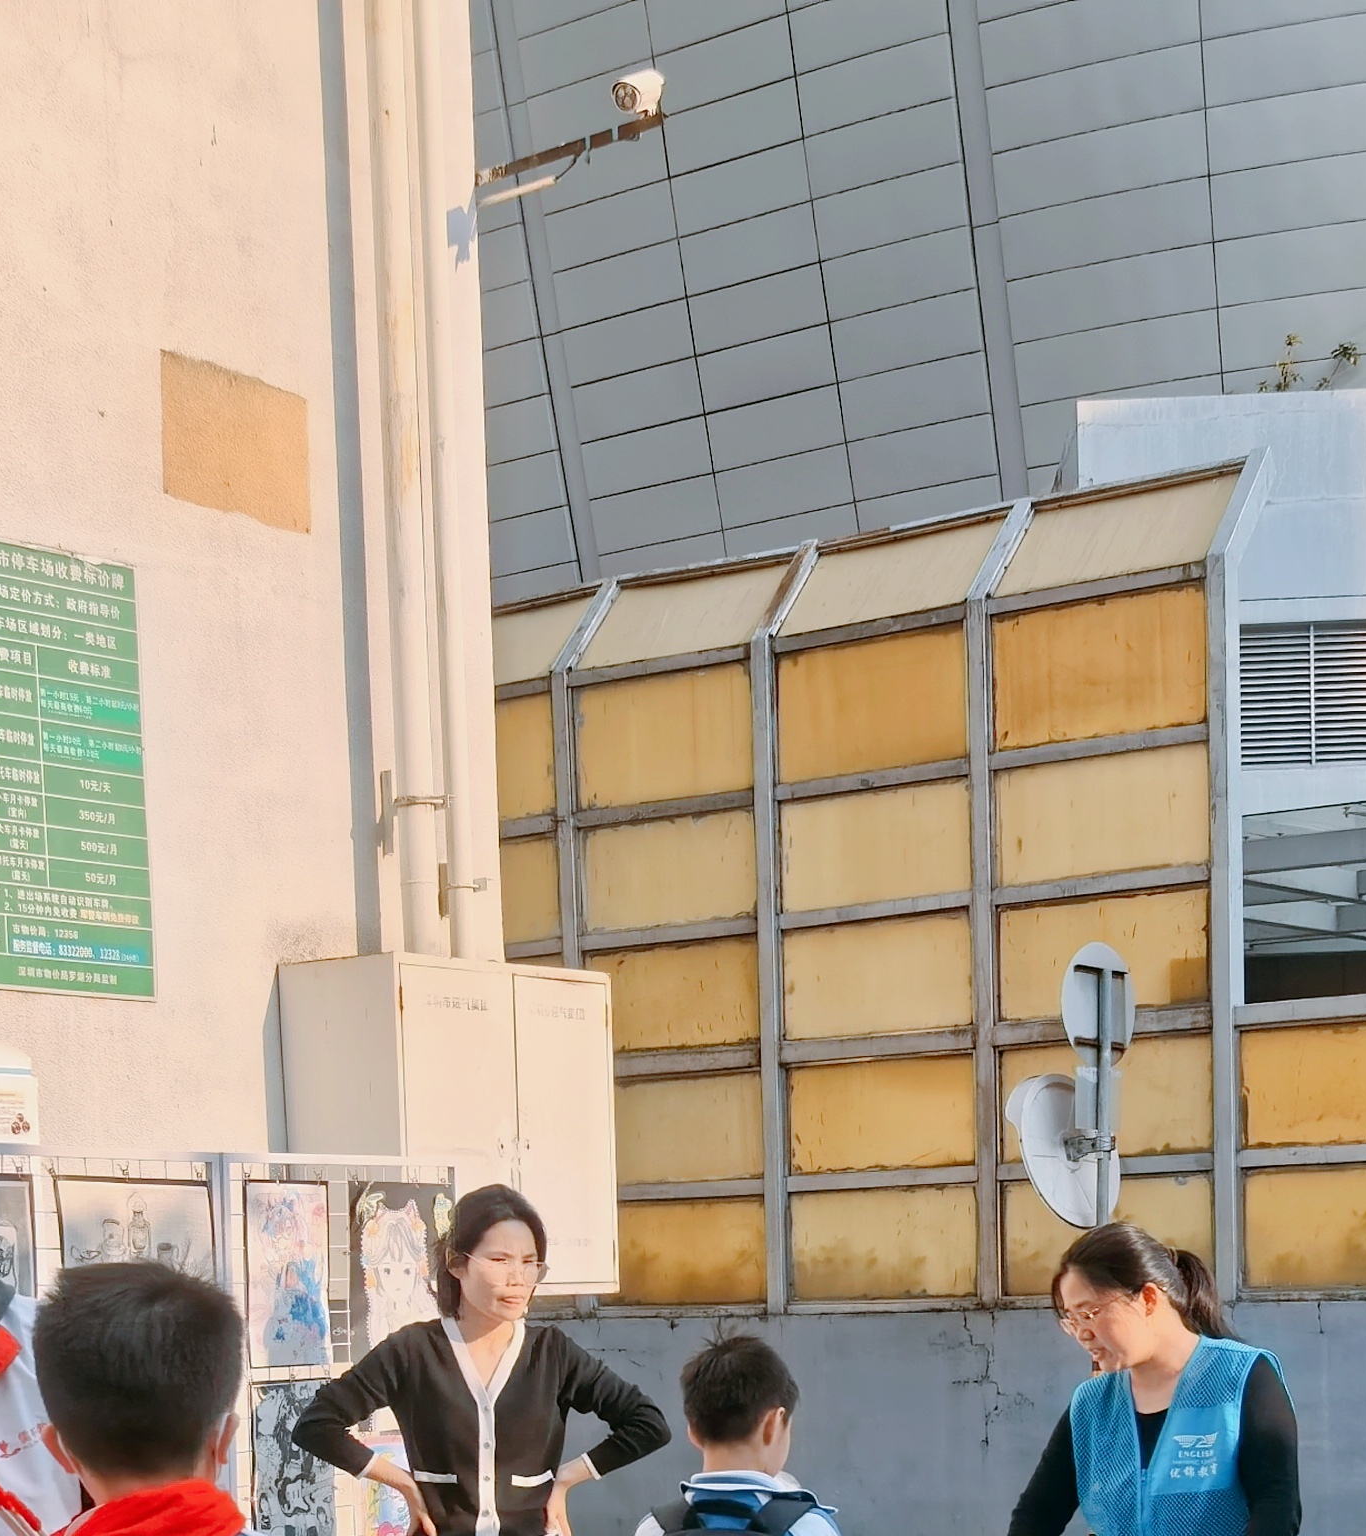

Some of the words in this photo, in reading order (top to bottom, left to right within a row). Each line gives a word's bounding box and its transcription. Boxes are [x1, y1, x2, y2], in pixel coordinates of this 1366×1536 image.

[68, 659, 111, 679] 收费标准
[80, 779, 111, 794] 10元/天
[79, 809, 115, 825] 350元/月
[81, 841, 117, 856] 500元/月
[85, 872, 117, 886] 50元/月
